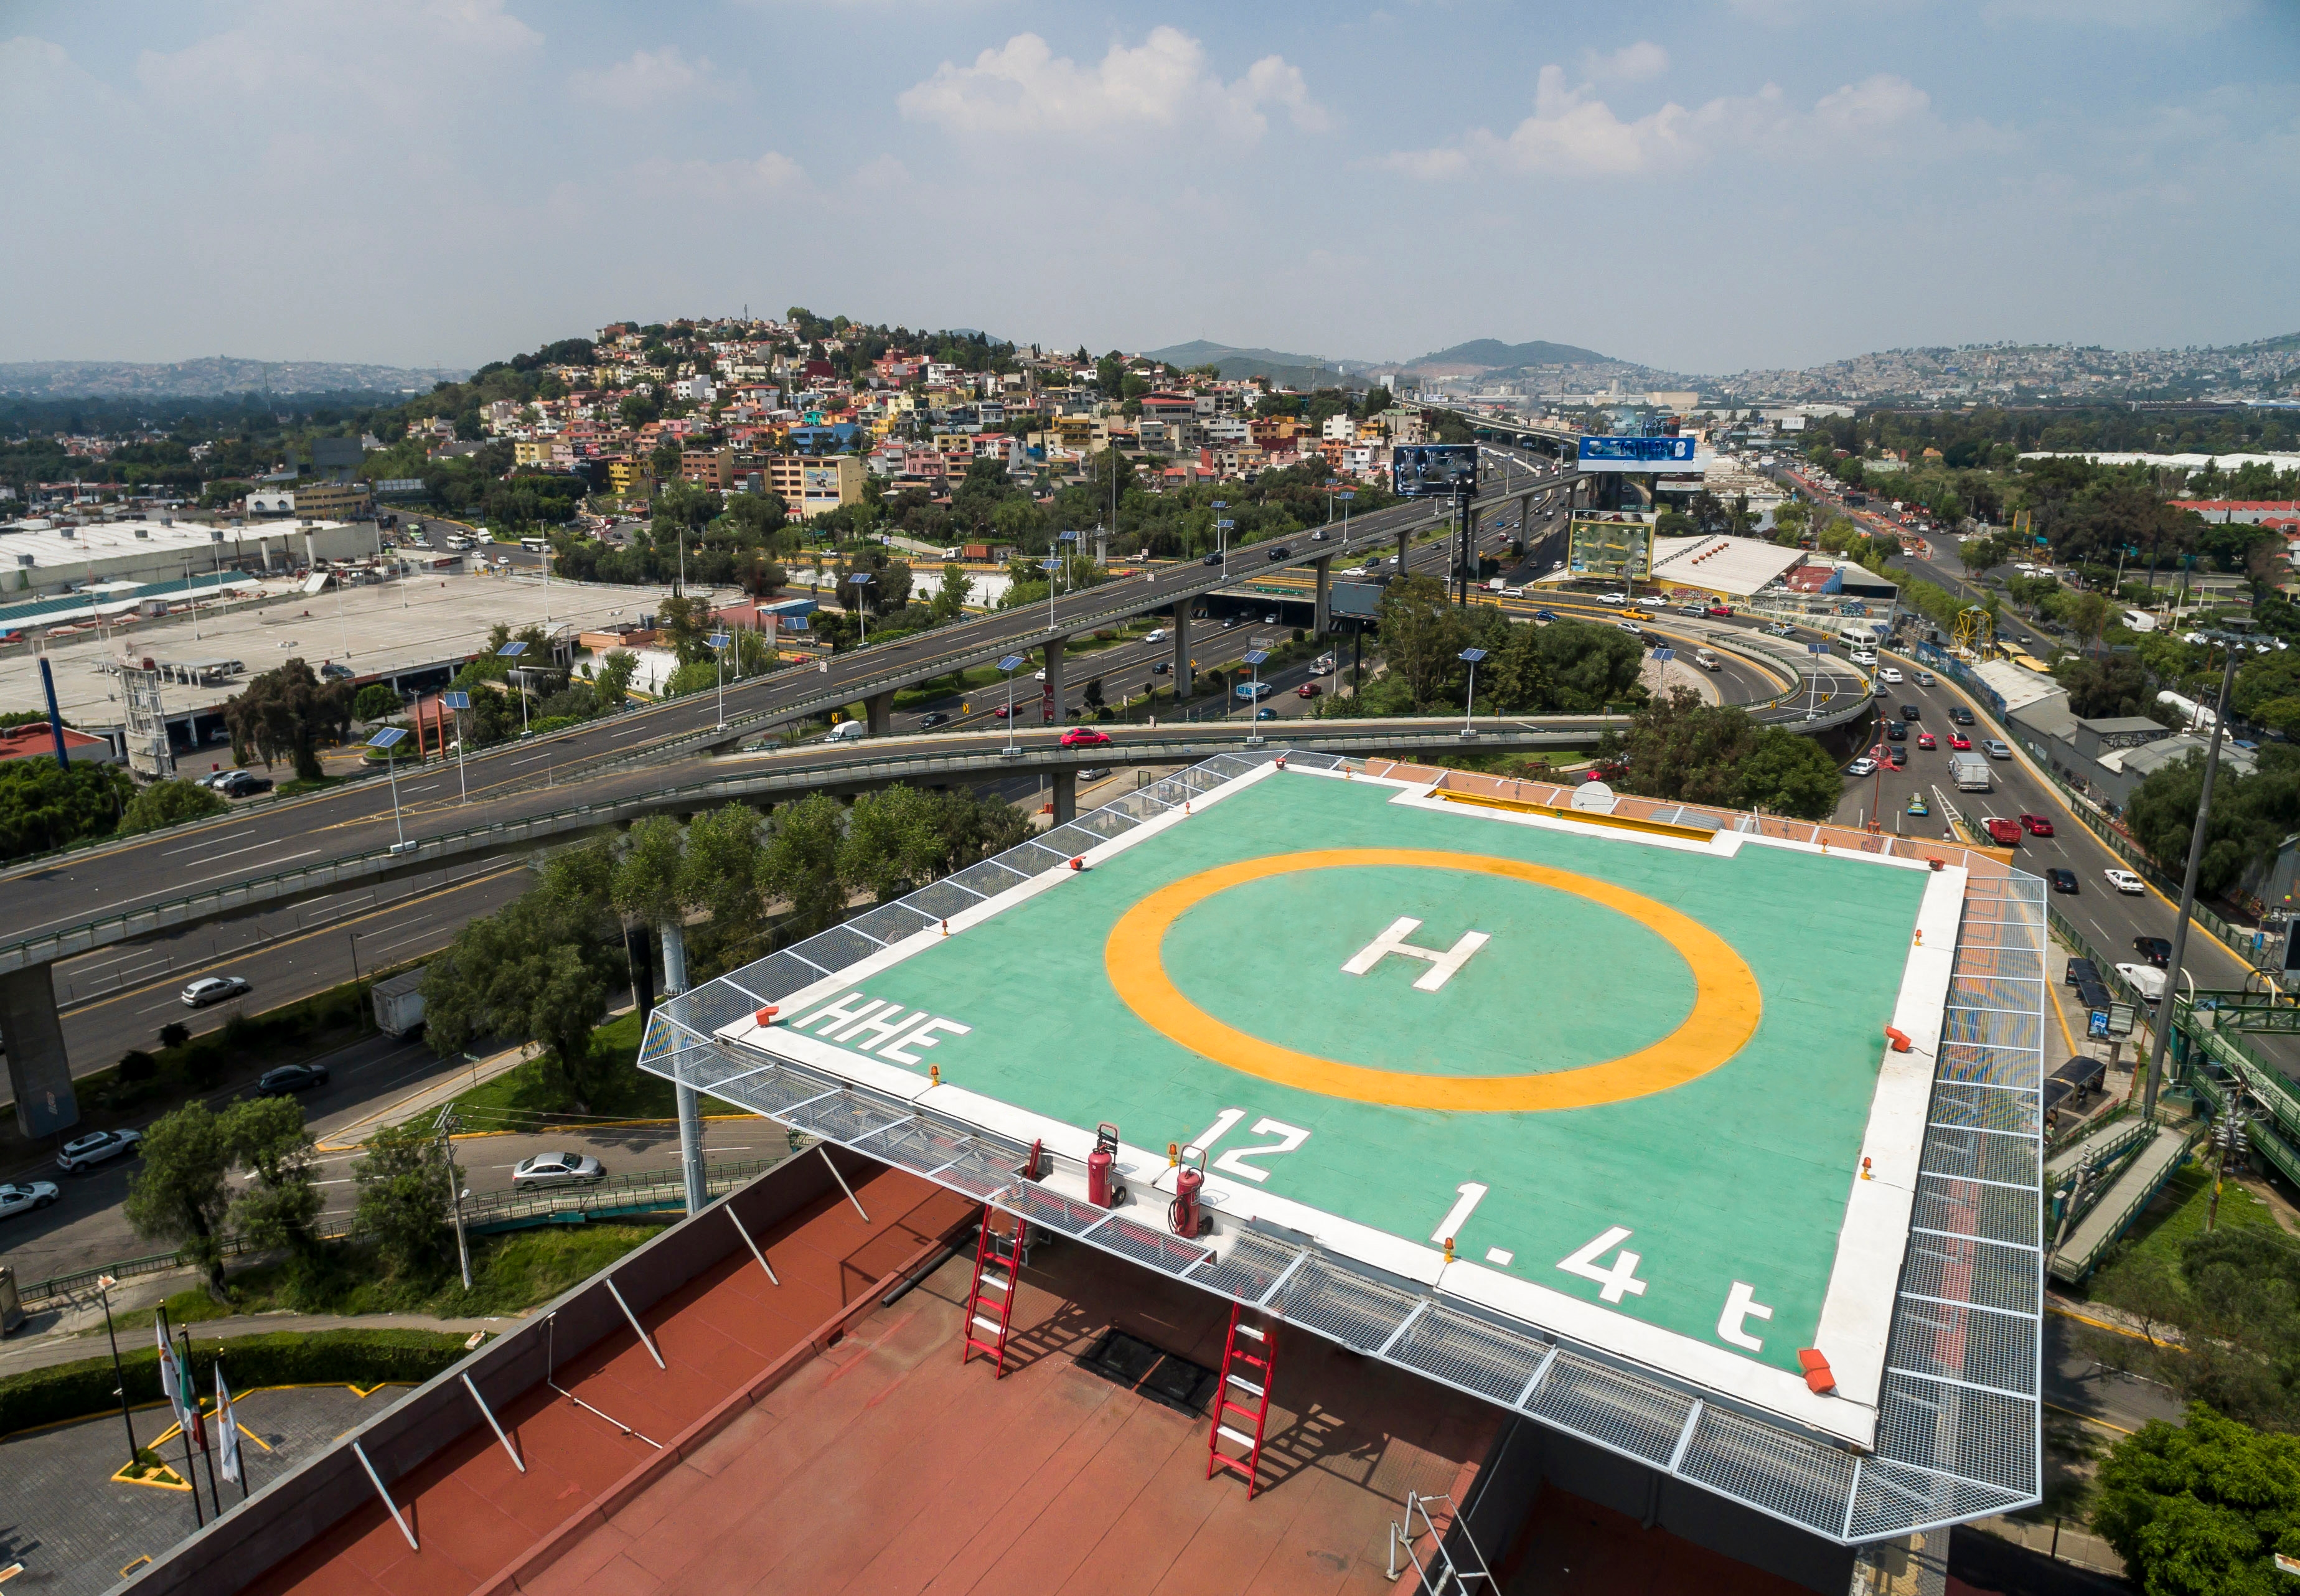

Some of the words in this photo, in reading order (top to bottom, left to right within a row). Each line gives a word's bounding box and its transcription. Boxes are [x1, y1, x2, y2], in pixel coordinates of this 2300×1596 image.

[1341, 916, 1490, 992] H
[791, 992, 972, 1066] HHE
[1183, 1108, 1311, 1183] 12
[1717, 1281, 1773, 1352] t
